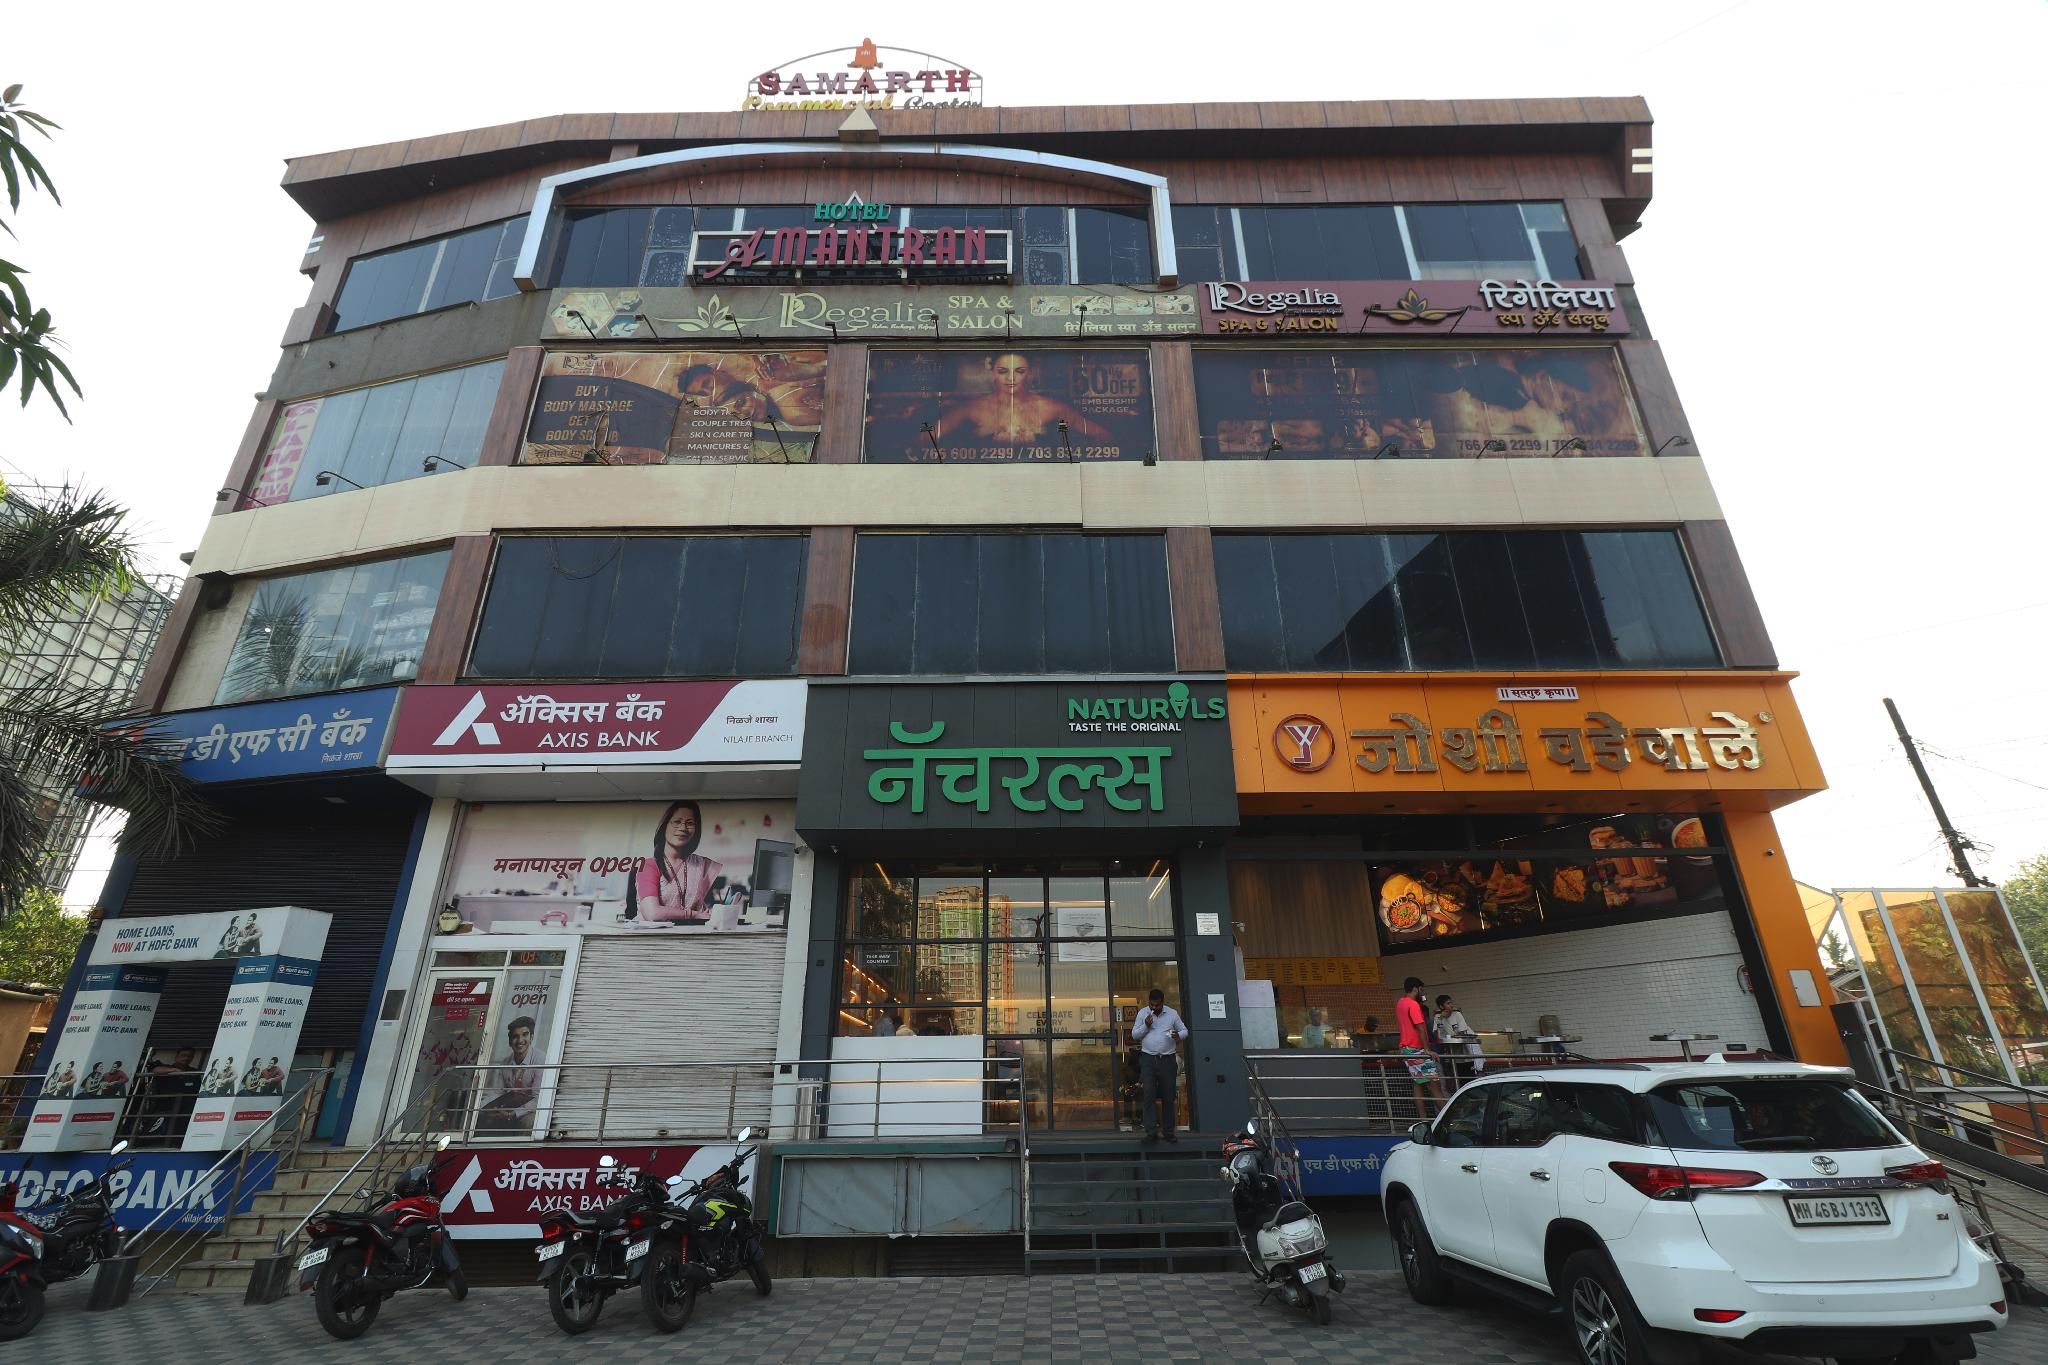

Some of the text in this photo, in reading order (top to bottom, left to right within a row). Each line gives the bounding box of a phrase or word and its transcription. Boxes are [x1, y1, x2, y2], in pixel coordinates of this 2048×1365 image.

[757, 69, 971, 95] SAMARTH
[815, 203, 892, 222] HOTEL
[703, 226, 986, 279] AMANTRAN
[1205, 282, 1342, 313] Regalia
[1480, 279, 1617, 309] रिगेलिया
[948, 296, 1014, 309] SPA &
[779, 292, 936, 331] Regalia
[947, 315, 1023, 329] SALON
[1219, 319, 1252, 331] SPA
[1256, 318, 1268, 331] &
[575, 386, 600, 397] BUY
[544, 400, 633, 413] BODY MASSAGE
[546, 430, 576, 442] BODY
[980, 447, 1013, 459] 2299
[1028, 447, 1051, 459] 703
[1086, 447, 1120, 458] 2299
[1456, 440, 1480, 451] 766
[1510, 440, 1541, 451] 2299
[616, 693, 666, 722] बँक
[1069, 723, 1182, 732] TASTE THE ORIGINAL
[537, 730, 662, 748] AXIS BANK
[755, 735, 793, 743] BRANCH
[1351, 709, 1527, 773] जोशी
[863, 721, 1172, 813] नॅचरल्स
[494, 856, 646, 879] मनापासून open
[117, 925, 175, 939] HOME LOANS,
[112, 937, 199, 953] NOW AT HDFC BANK
[511, 994, 548, 1008] open
[527, 1195, 572, 1212] AXIS
[1793, 1202, 1812, 1219] MH
[1849, 1202, 1882, 1218] 1313
